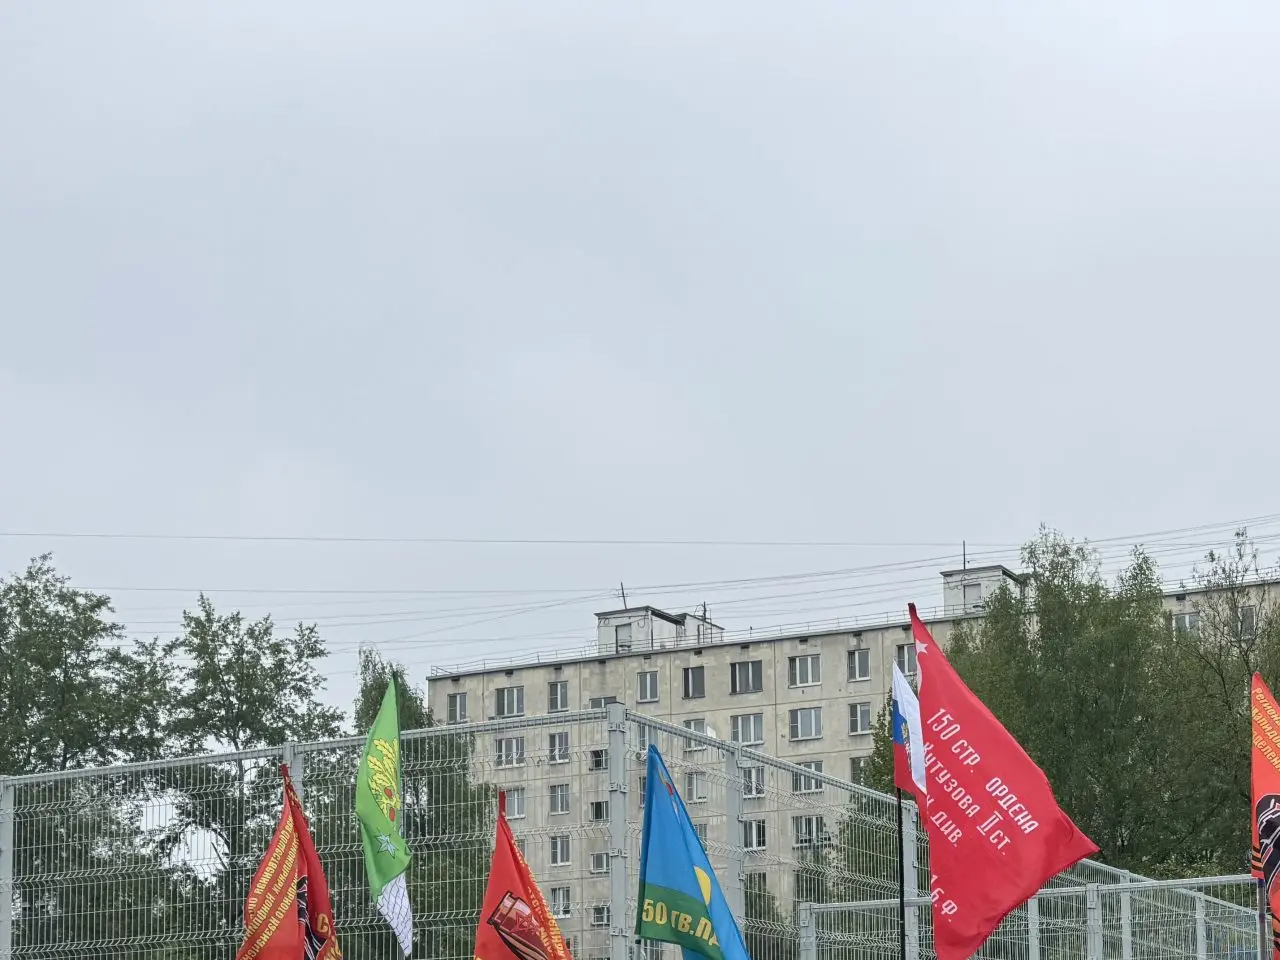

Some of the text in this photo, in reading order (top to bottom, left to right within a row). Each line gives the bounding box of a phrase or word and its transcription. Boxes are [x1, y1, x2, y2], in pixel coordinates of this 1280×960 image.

[927, 708, 961, 741] 150
[985, 777, 1040, 834] ОРДЕНА
[642, 899, 668, 925] 50
